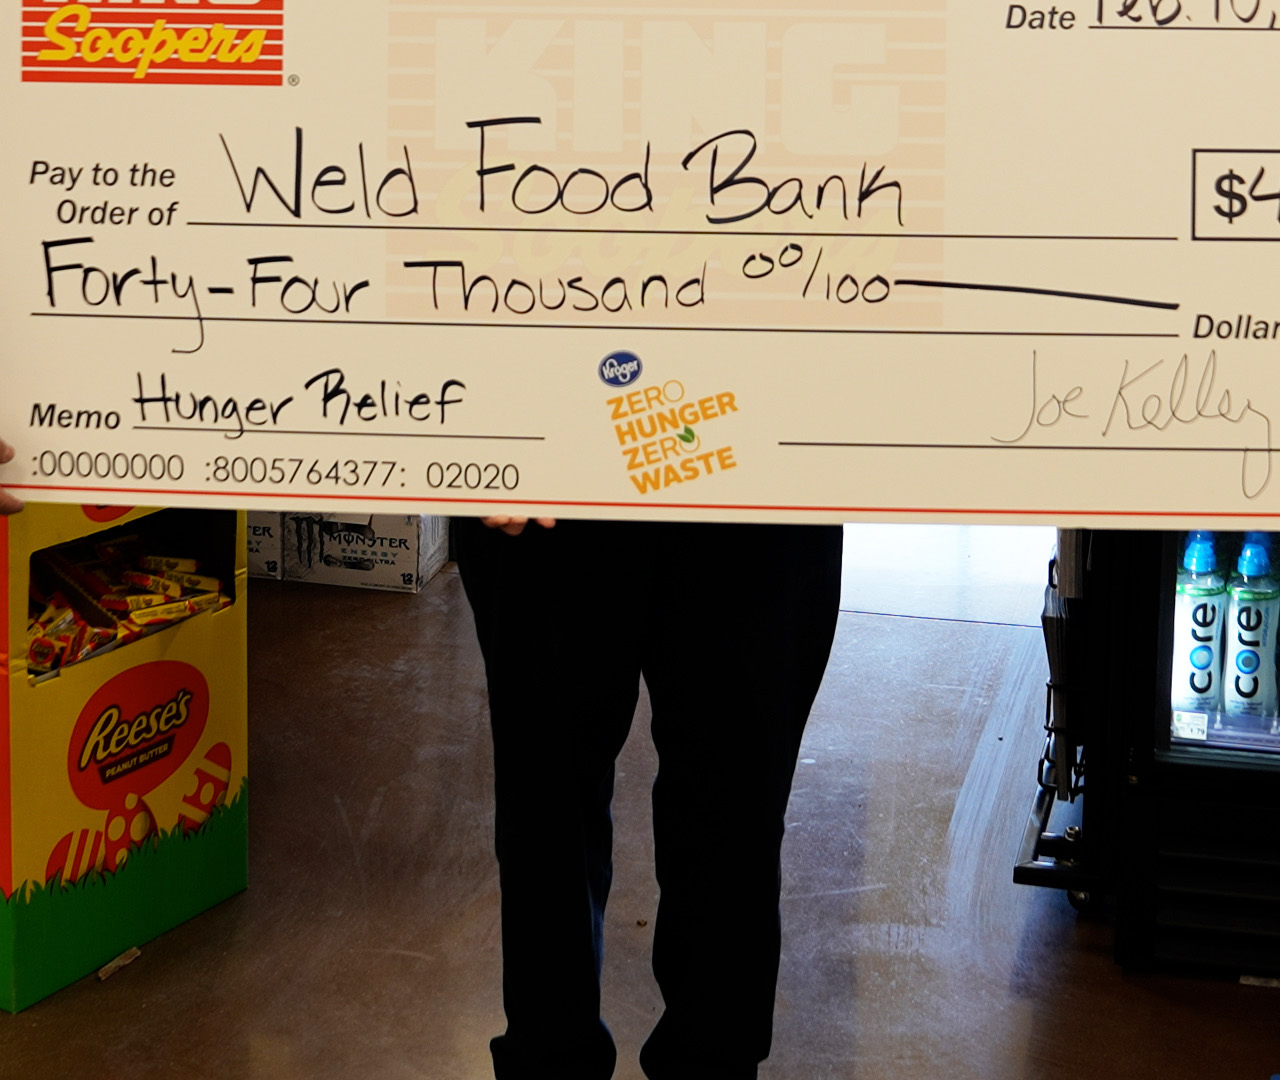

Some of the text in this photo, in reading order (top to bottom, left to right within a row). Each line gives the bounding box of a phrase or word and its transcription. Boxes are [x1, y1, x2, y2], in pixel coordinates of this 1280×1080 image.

[1005, 4, 1076, 31] Date
[35, 3, 267, 79] Soopers
[28, 158, 177, 194] Pay to the
[218, 115, 905, 227] Weld Food Bank
[55, 199, 178, 226] Order of
[40, 235, 371, 354] Forty-Four
[403, 259, 708, 315] Thousand
[600, 356, 641, 380] Kroger
[28, 403, 122, 431] Memo
[131, 368, 467, 440] Hunger Relief
[605, 378, 686, 422] ZERO
[612, 389, 740, 446] HUNGER
[990, 349, 1090, 445] Joe
[203, 453, 409, 490] :8005764377:
[426, 460, 521, 492] 02020
[621, 427, 702, 473] ZERO
[628, 445, 738, 496] WASTE
[328, 529, 410, 552] MONSTER
[340, 547, 399, 559] ENERGY
[400, 572, 414, 585] 12
[1187, 603, 1217, 695] core
[1234, 605, 1263, 699] core
[76, 688, 194, 772] Reese's
[104, 743, 170, 780] PEANUT BUTTER
